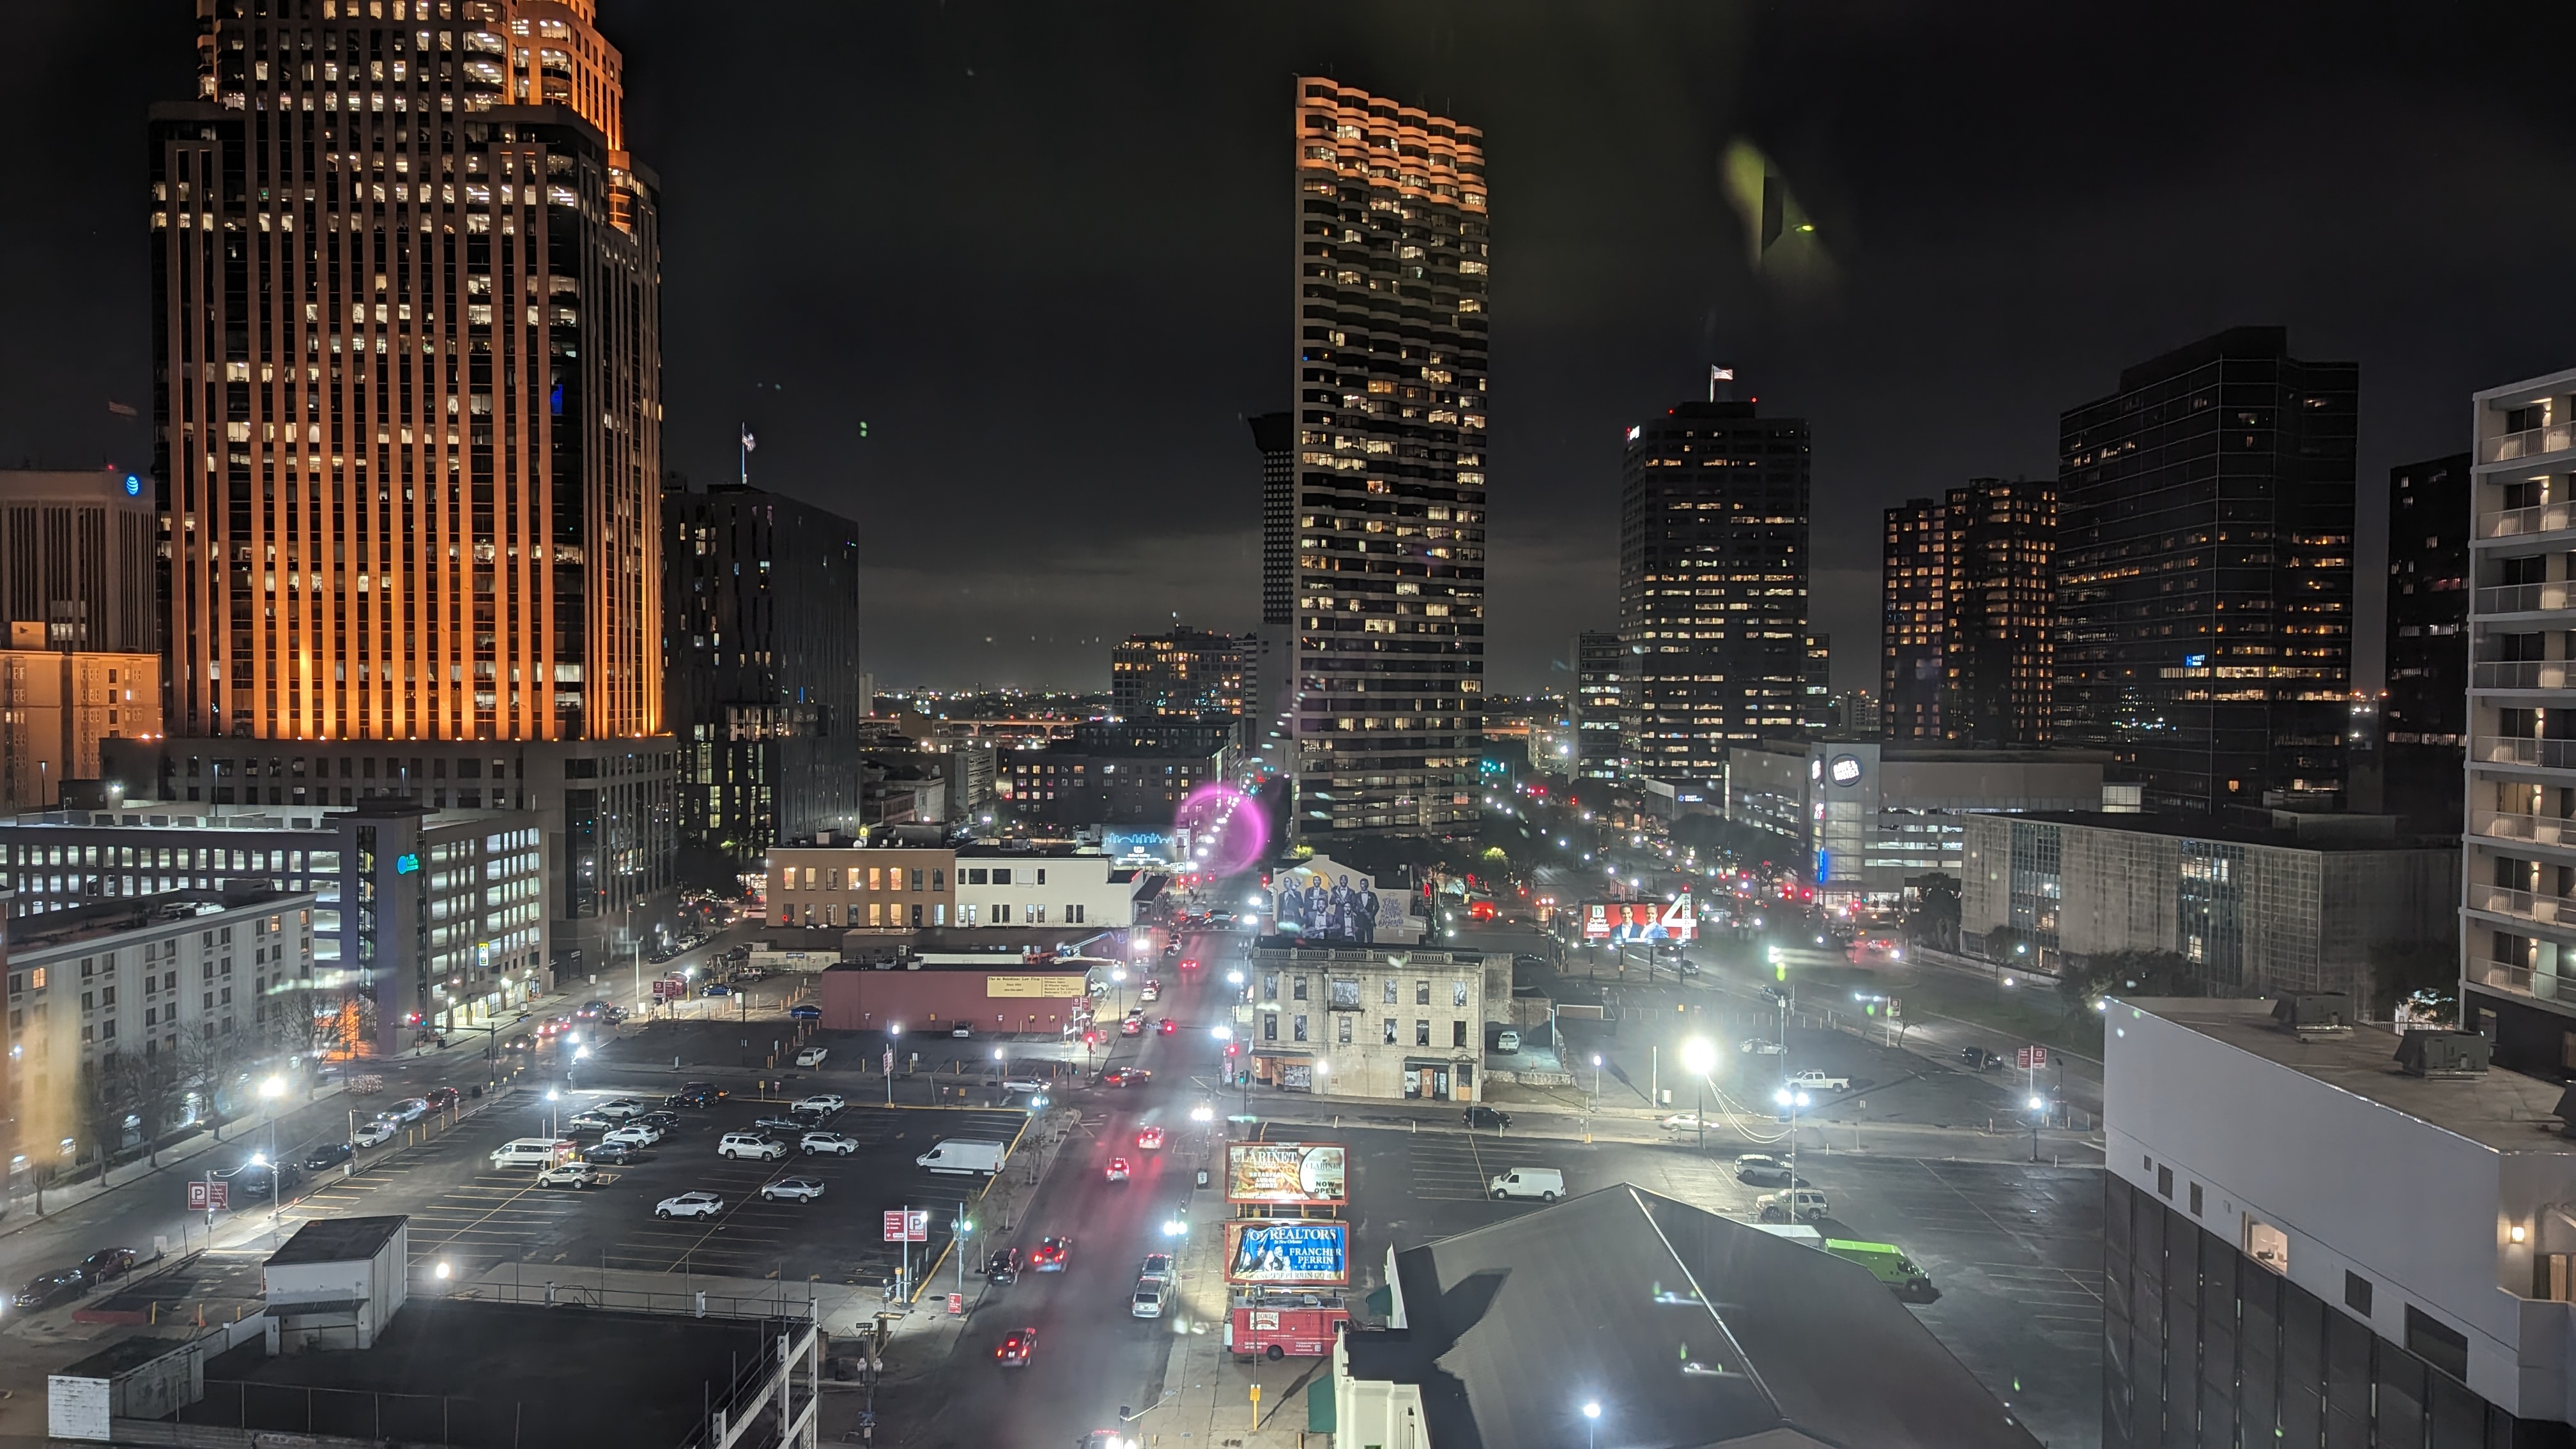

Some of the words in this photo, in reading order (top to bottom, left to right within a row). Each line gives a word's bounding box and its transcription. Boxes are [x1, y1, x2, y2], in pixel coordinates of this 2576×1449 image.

[1232, 1151, 1298, 1163] CLARINET
[1270, 1229, 1336, 1240] REALTORS
[1298, 1256, 1333, 1264] PERRIN
